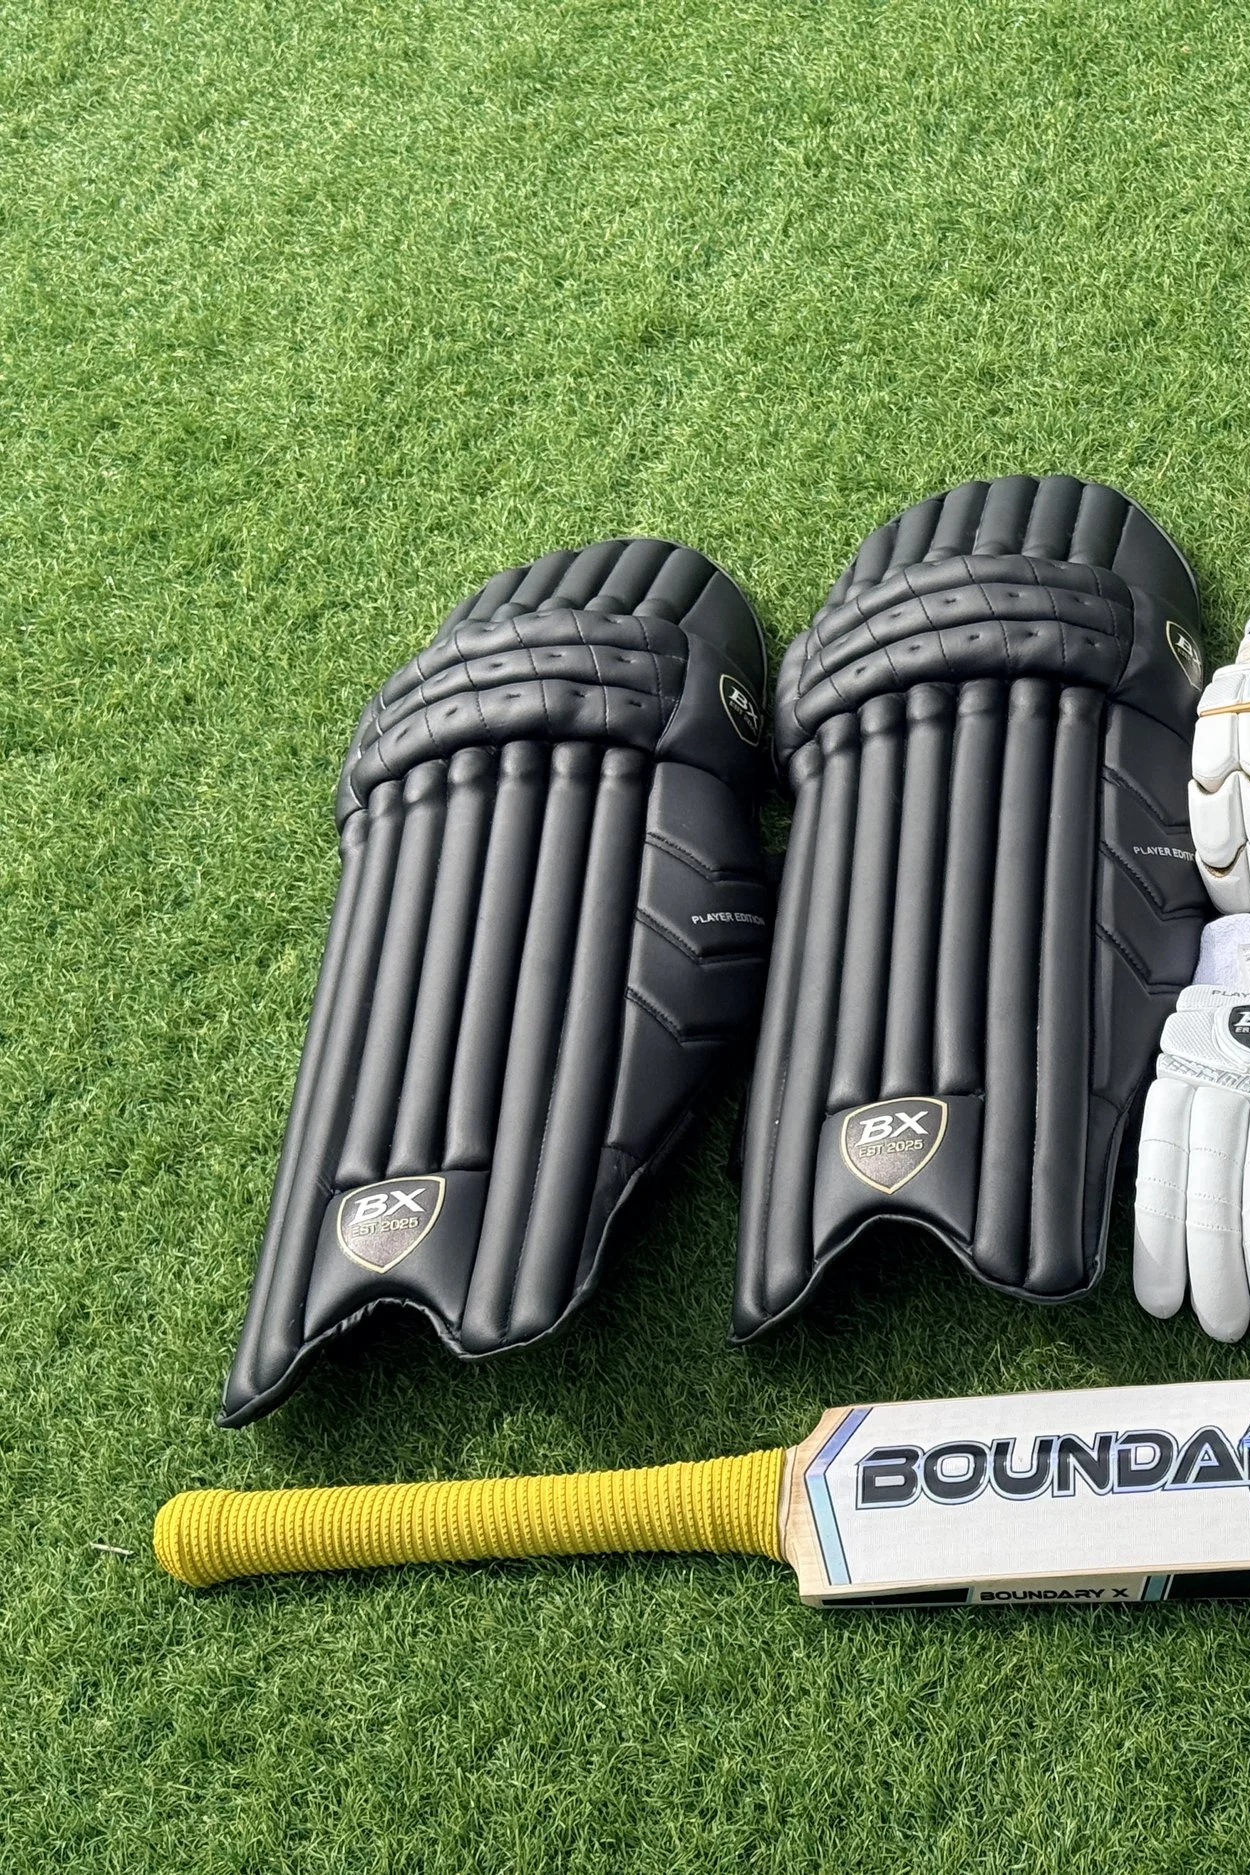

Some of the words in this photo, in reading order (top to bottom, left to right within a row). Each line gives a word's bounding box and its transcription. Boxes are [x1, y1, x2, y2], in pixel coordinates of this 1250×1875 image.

[1133, 846, 1172, 857] PLAYER
[691, 912, 734, 925] PLAYER
[854, 1111, 929, 1147] BX
[859, 1144, 884, 1158] EST
[886, 1139, 924, 1154] 2025
[348, 1188, 426, 1226] BX
[352, 1222, 377, 1237] EST
[380, 1217, 420, 1232] 2025
[980, 1588, 1106, 1601] BOUNDARY
[1111, 1587, 1130, 1599] X
